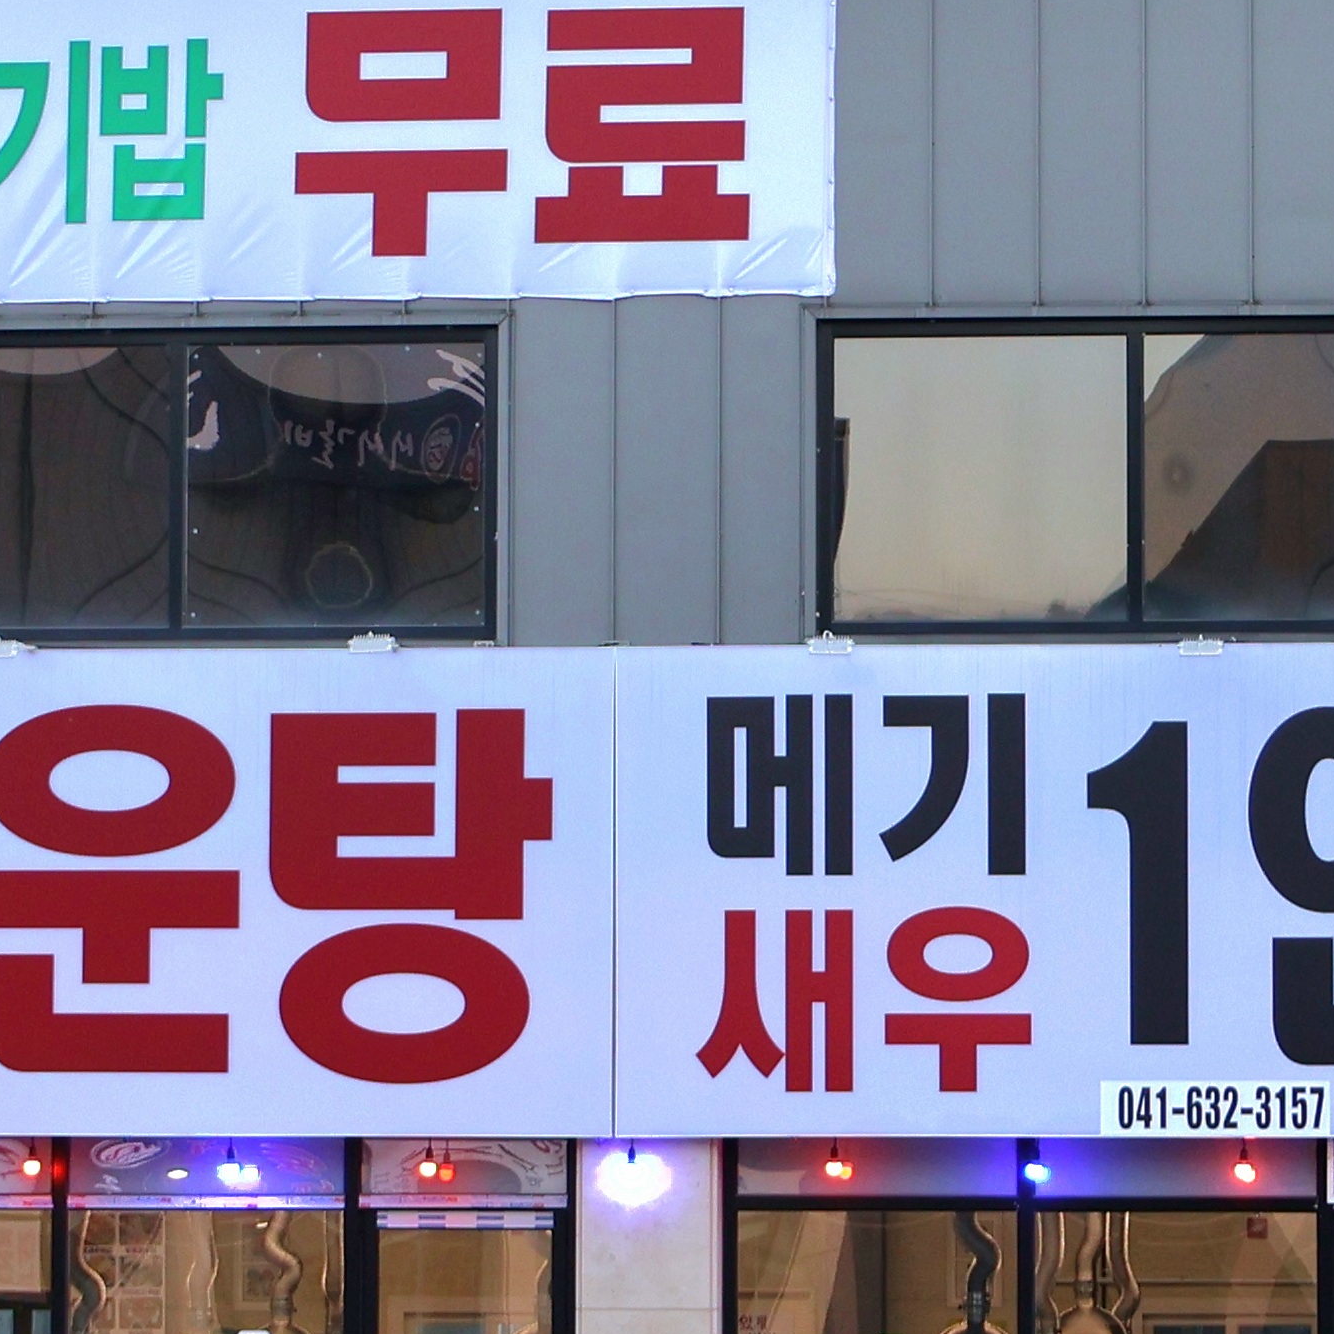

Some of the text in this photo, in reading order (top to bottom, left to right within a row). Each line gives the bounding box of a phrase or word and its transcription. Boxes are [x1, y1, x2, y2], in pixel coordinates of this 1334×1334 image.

[295, 7, 750, 257] 무료
[707, 693, 1026, 876] 메기
[696, 907, 1032, 1092] 새우
[1118, 1085, 1325, 1130] 041-632-3157
